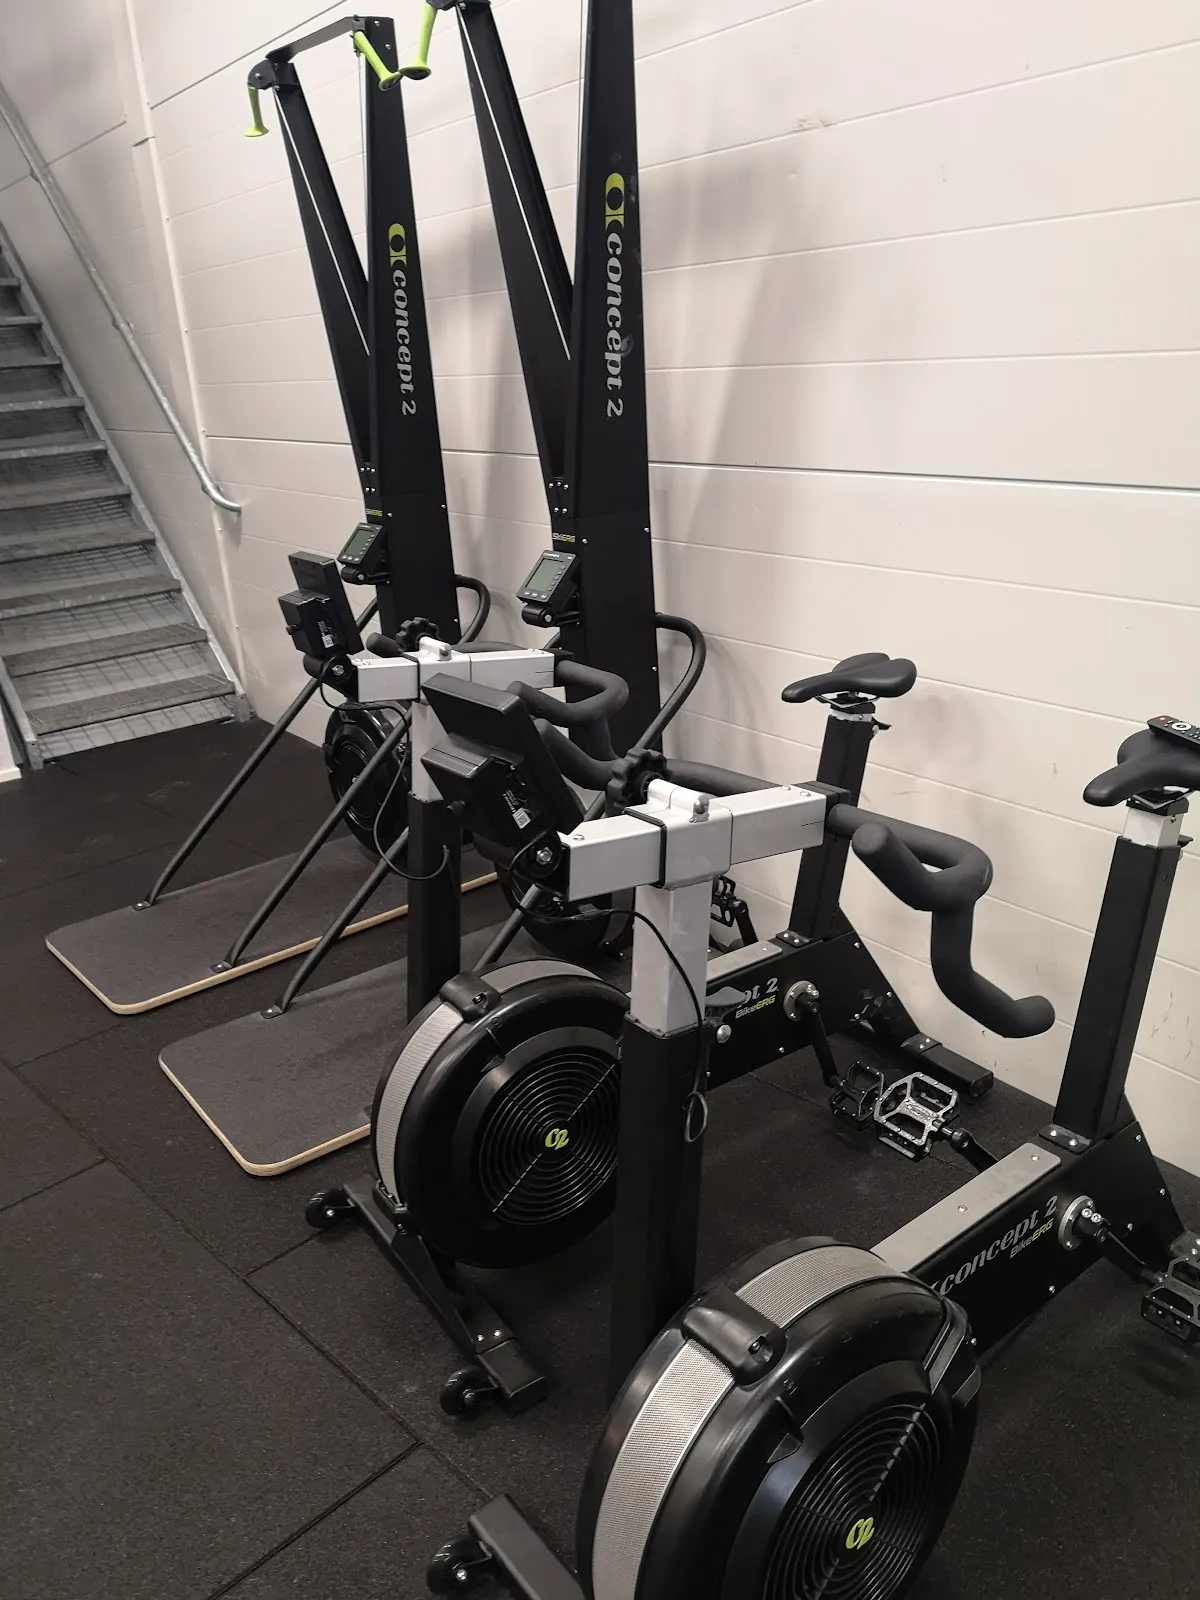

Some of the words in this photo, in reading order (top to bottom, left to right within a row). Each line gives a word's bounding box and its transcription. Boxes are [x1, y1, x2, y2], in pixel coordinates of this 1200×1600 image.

[605, 232, 623, 391] concept
[392, 269, 415, 394] concept
[401, 399, 417, 416] 2
[606, 398, 624, 417] 2
[765, 977, 780, 994] 2
[735, 994, 777, 1019] BikeERG
[940, 1209, 1040, 1296] concept
[1043, 1195, 1058, 1219] 2
[1009, 1217, 1054, 1259] BikeERG
